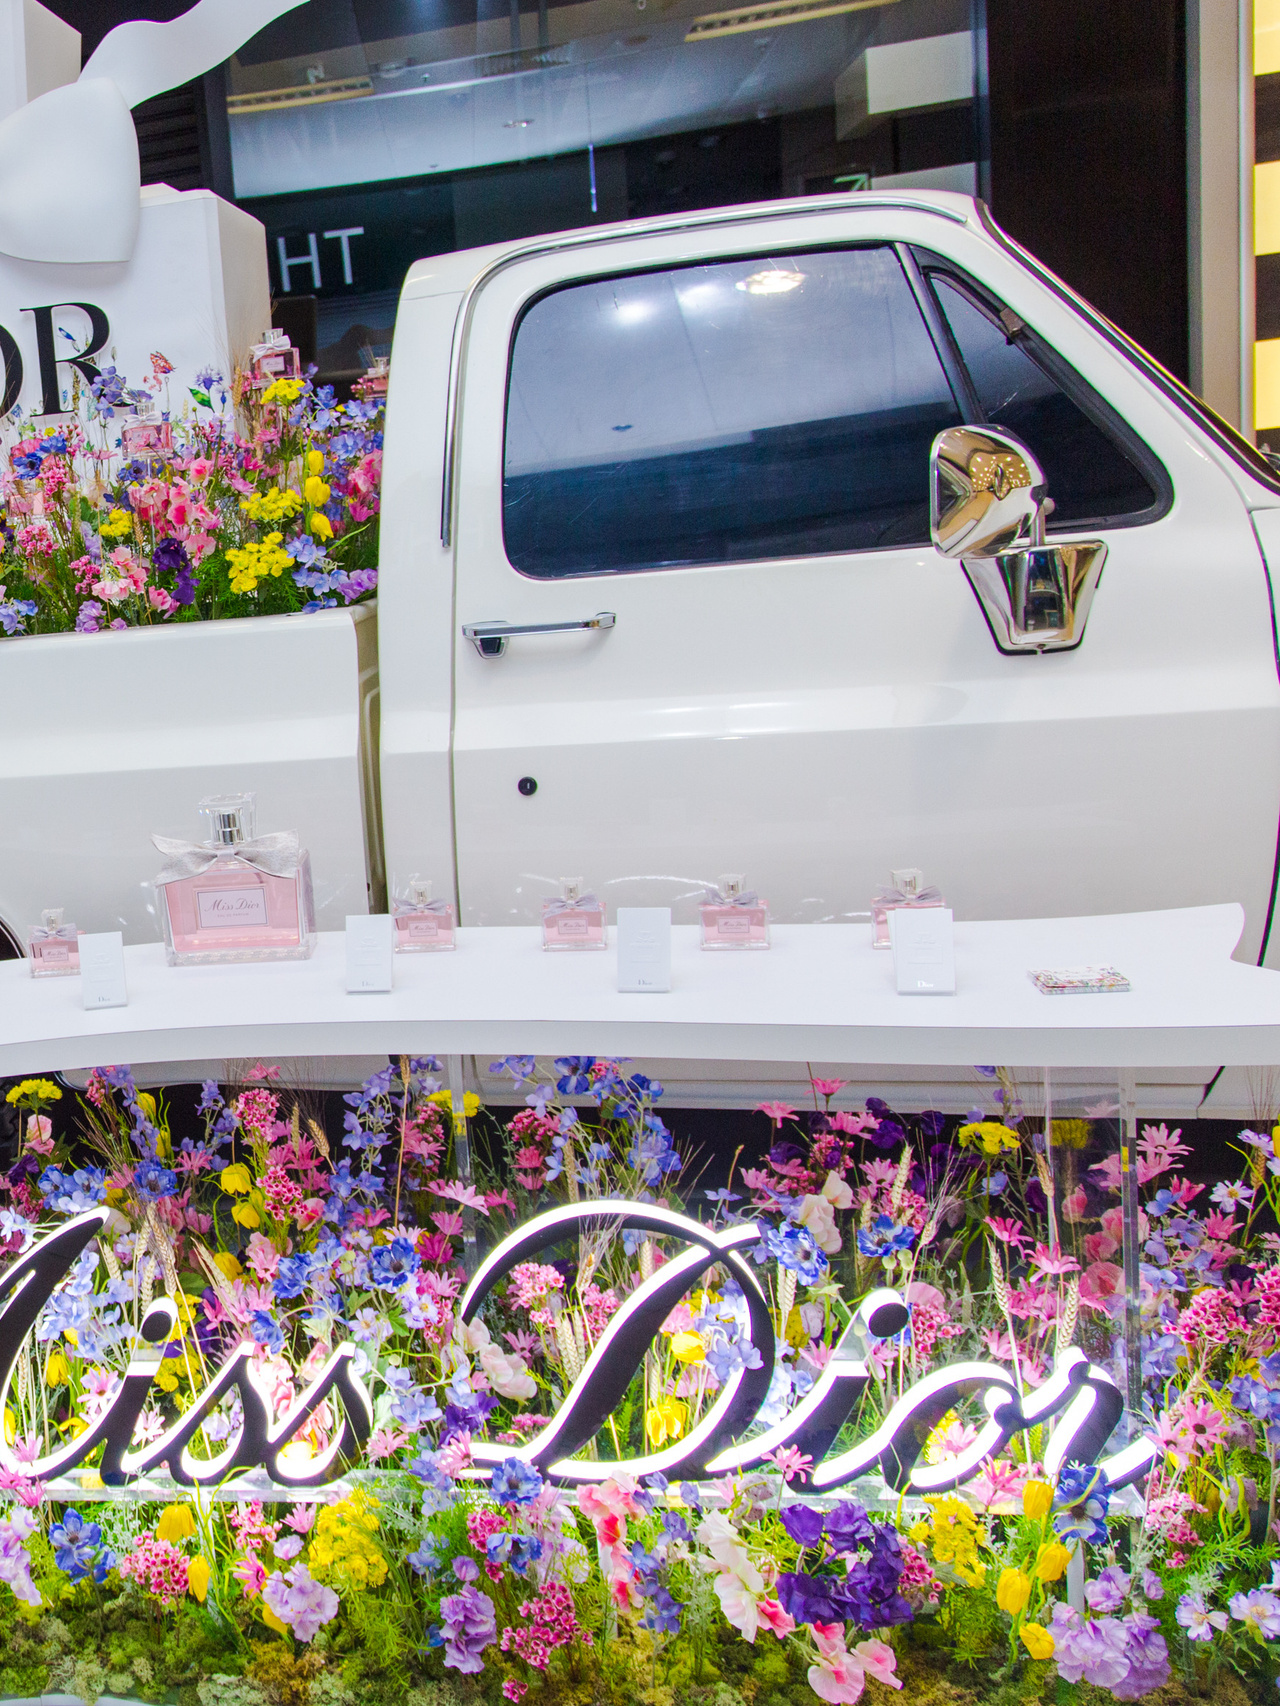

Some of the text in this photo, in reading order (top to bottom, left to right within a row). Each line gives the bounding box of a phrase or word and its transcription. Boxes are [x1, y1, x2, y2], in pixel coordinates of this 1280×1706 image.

[204, 897, 260, 912] Miss Dior
[459, 1198, 1166, 1494] Dior
